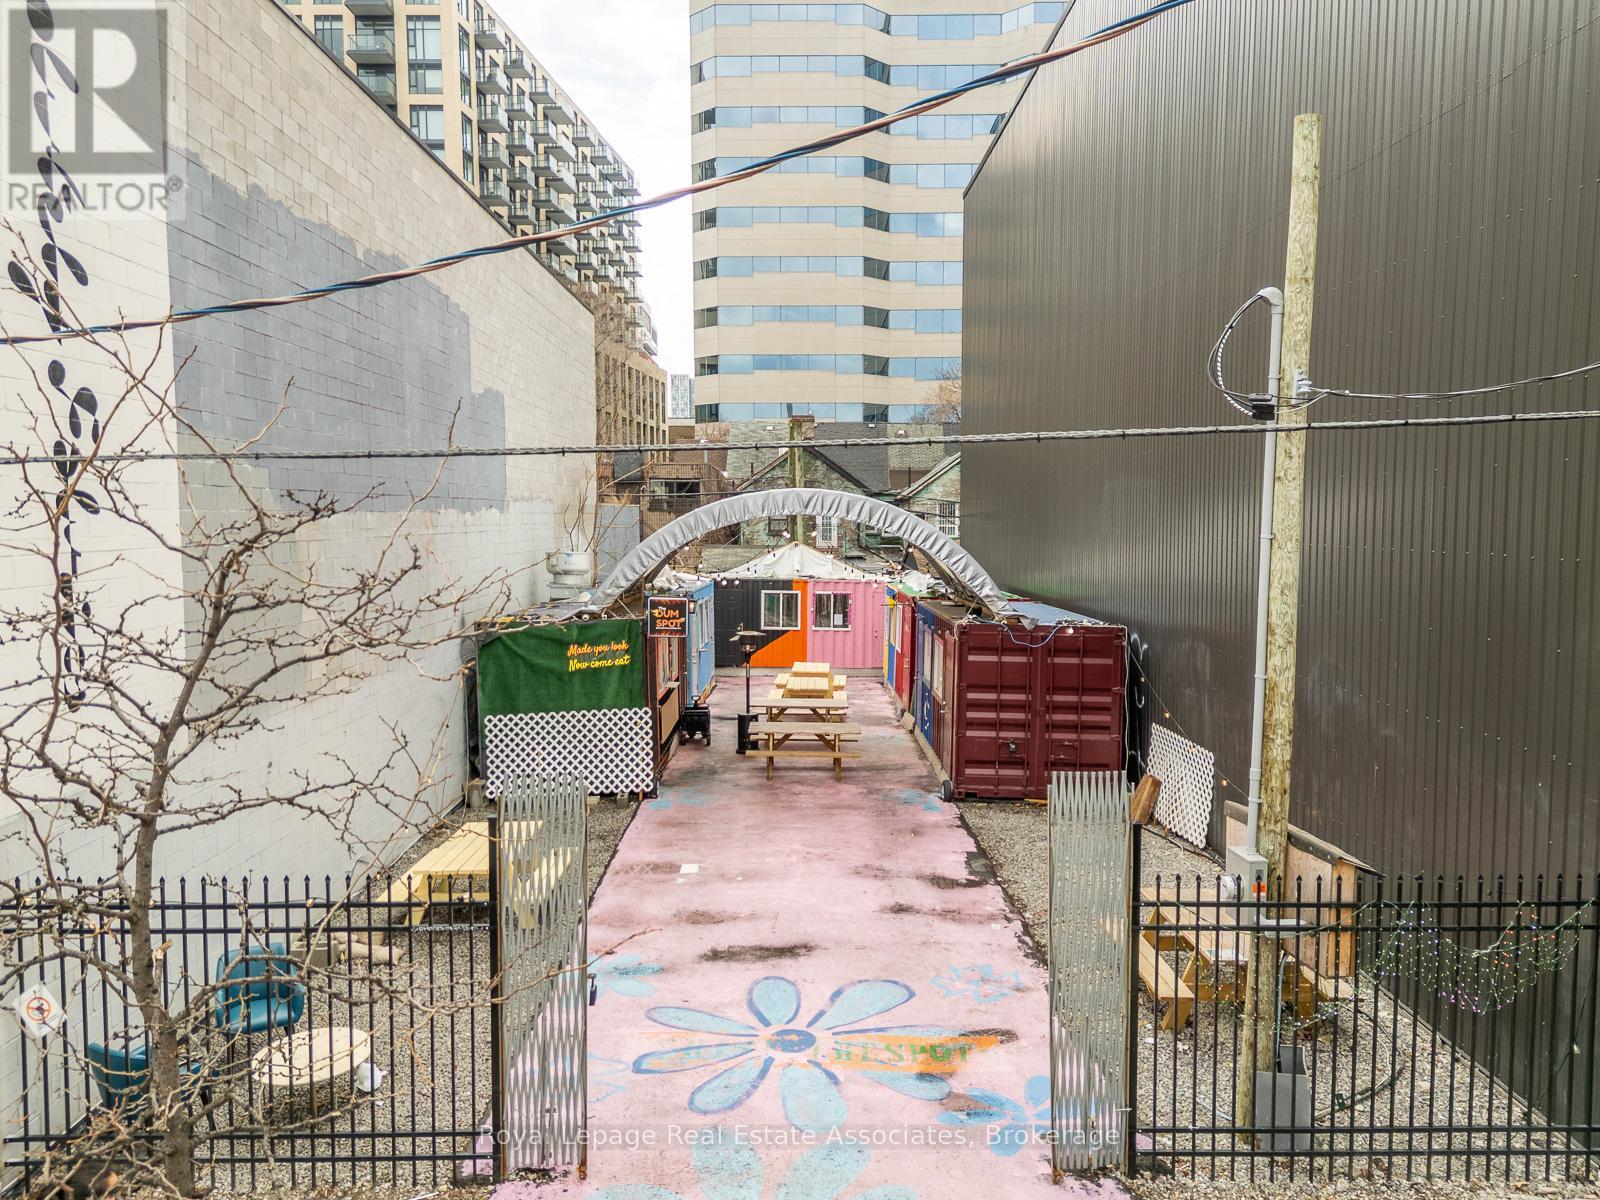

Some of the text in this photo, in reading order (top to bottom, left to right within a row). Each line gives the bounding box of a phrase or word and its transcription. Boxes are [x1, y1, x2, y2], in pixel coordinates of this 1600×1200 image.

[656, 618, 683, 628] SPOT
[567, 640, 629, 657] Made you look
[569, 654, 630, 672] Now come eat
